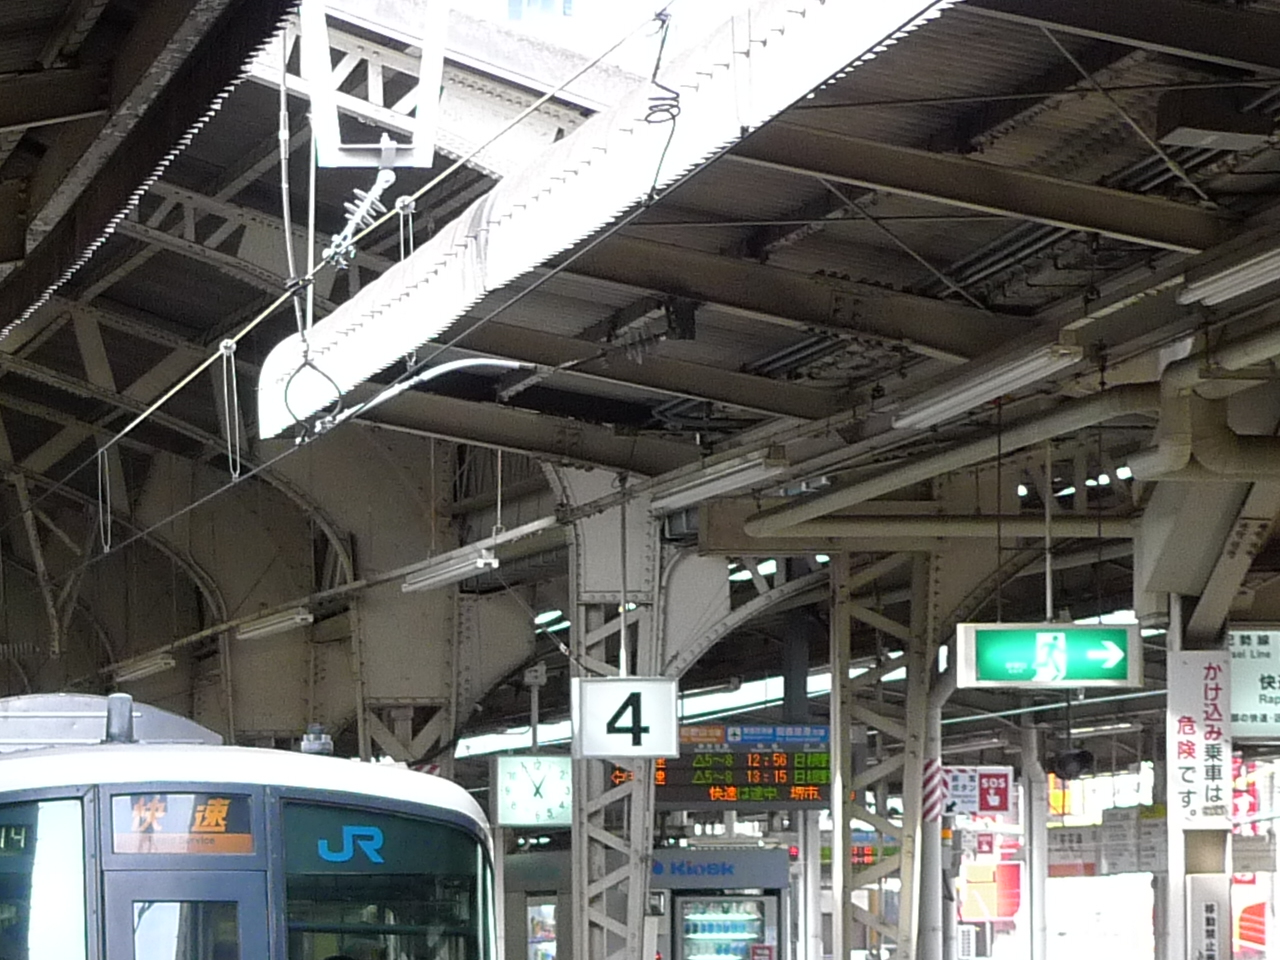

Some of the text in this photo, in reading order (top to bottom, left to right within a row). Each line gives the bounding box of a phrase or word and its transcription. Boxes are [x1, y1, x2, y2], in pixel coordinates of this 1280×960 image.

[1259, 674, 1280, 691] 快
[1259, 694, 1280, 706] Rap
[606, 691, 650, 747] 4
[1203, 661, 1223, 803] かけ込み乗車は
[981, 777, 1006, 789] SOS
[1177, 715, 1197, 817] 危険です。
[131, 797, 230, 833] 快速
[317, 825, 385, 864] JR
[671, 861, 735, 876] Kiosk
